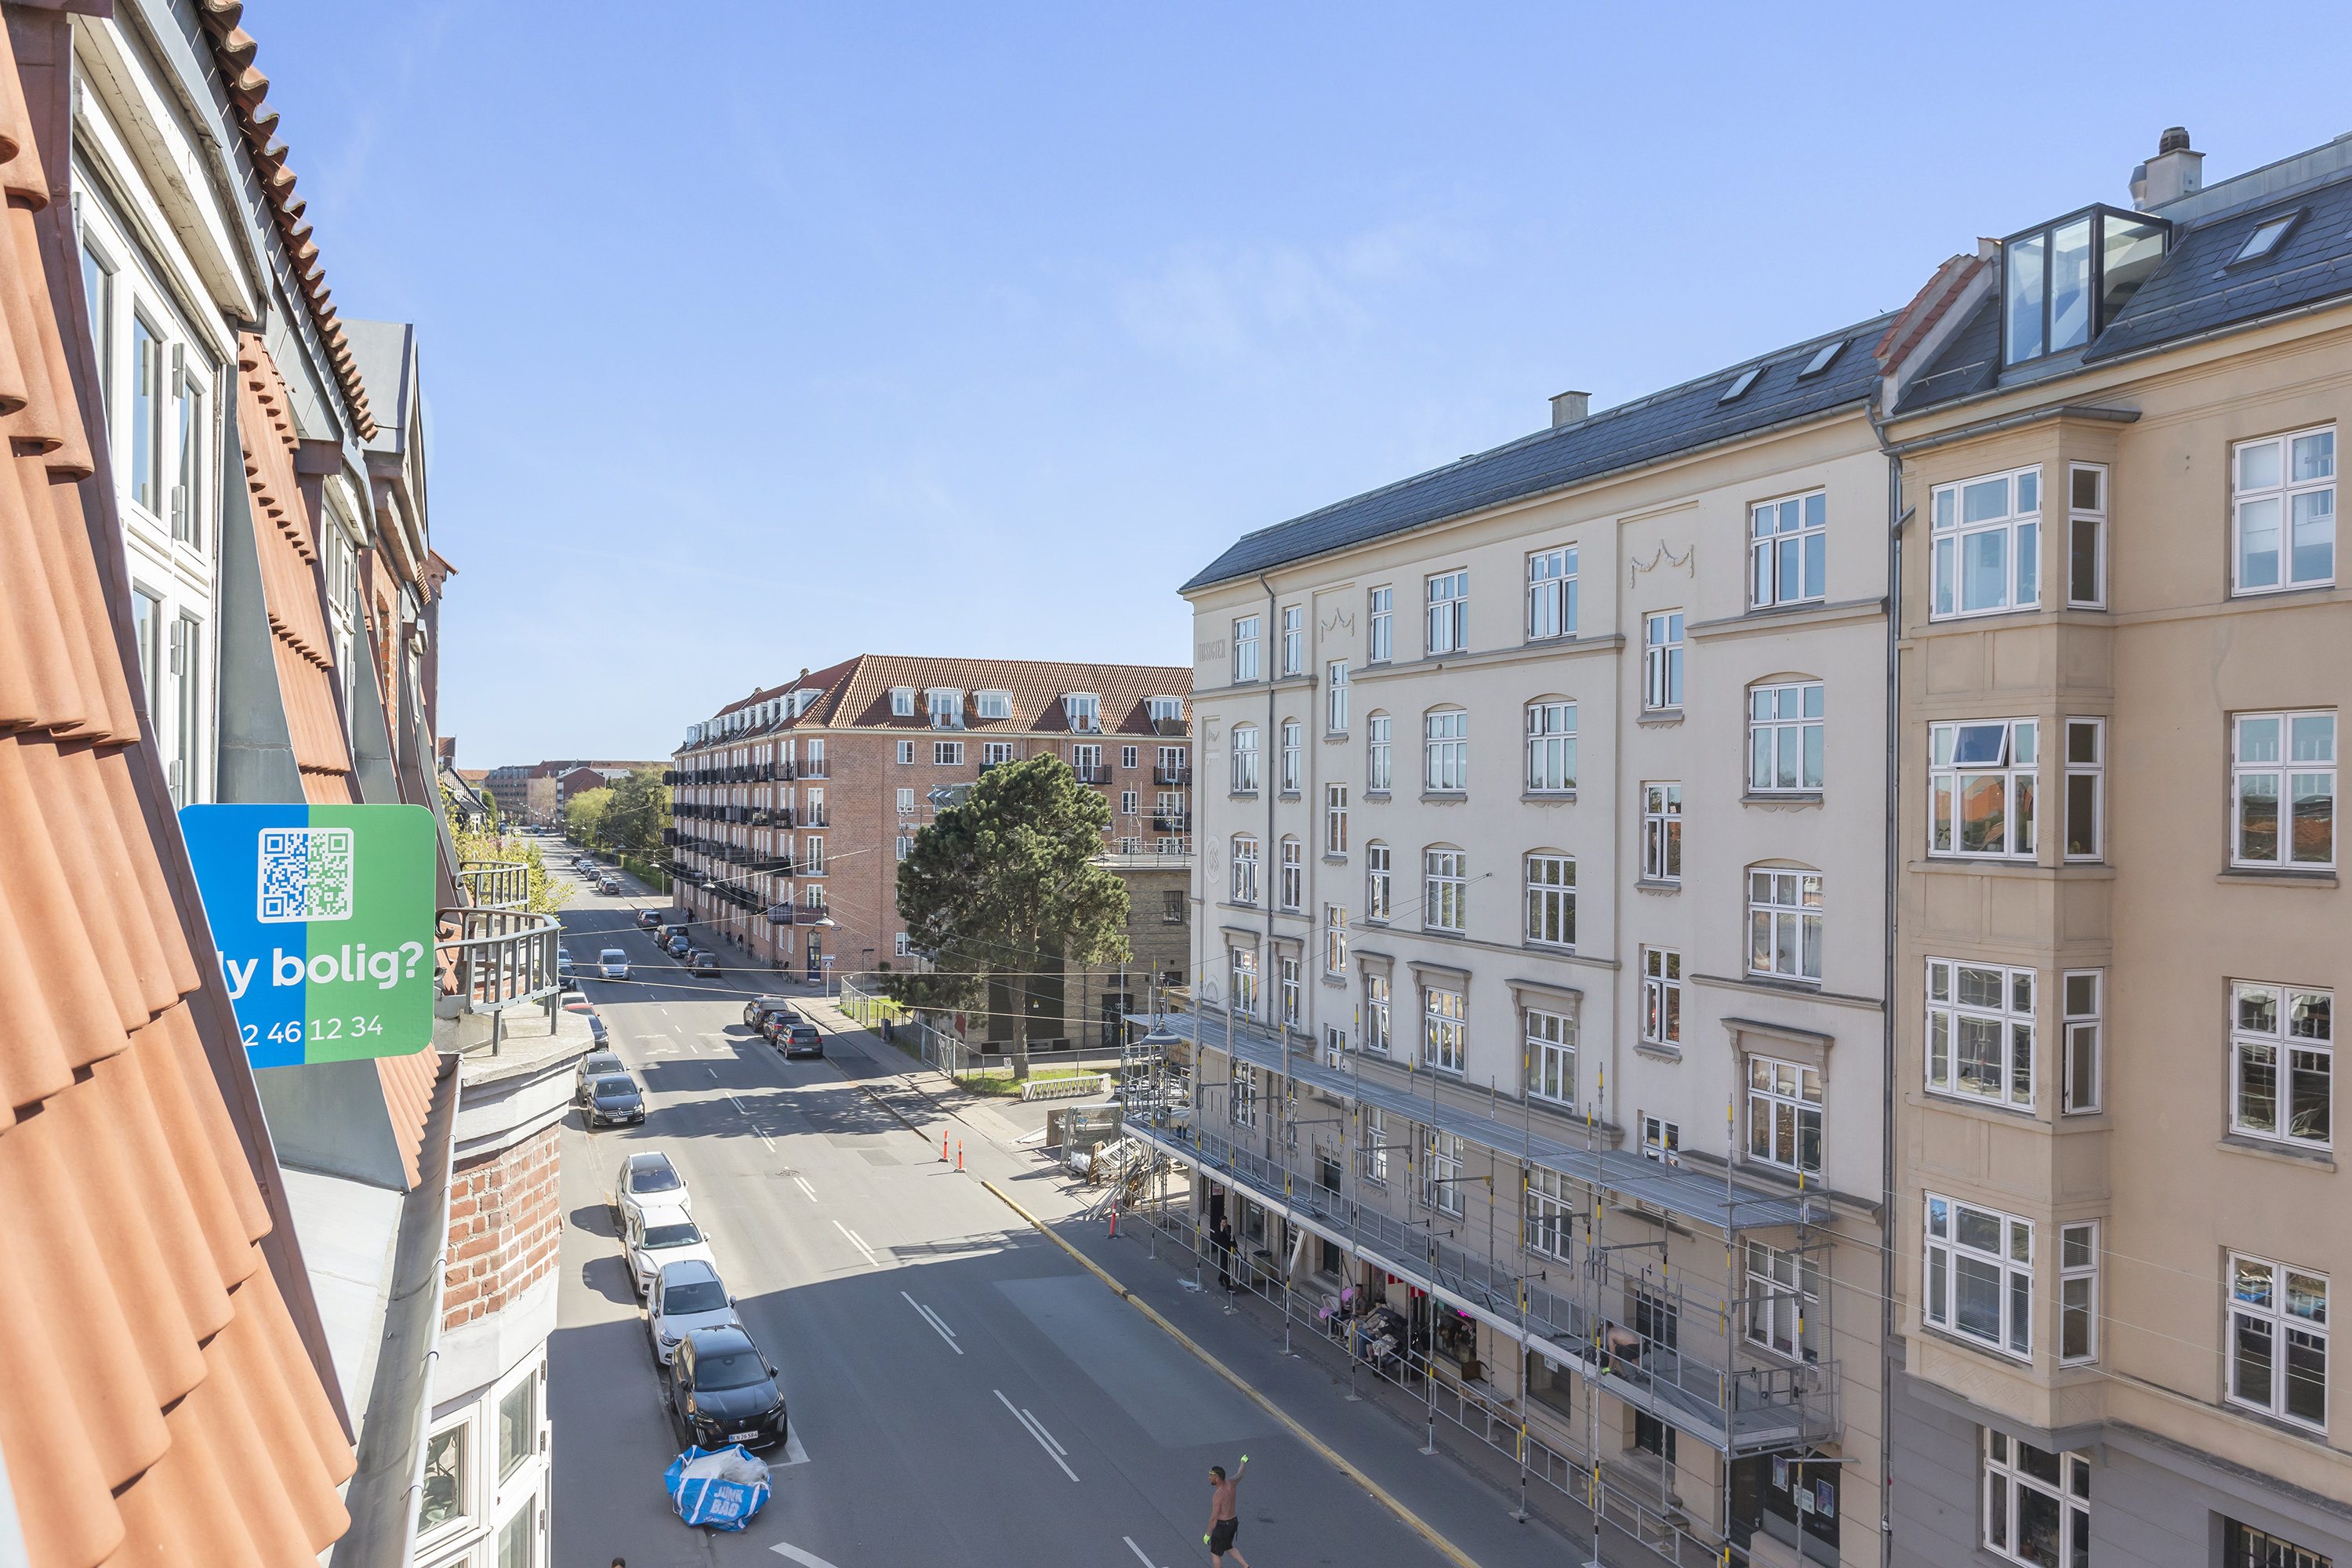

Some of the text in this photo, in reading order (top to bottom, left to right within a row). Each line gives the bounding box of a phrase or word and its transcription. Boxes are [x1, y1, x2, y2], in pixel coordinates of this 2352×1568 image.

[272, 941, 424, 989] bolig?
[242, 1015, 383, 1047] 2 46 12 34
[713, 1486, 744, 1503] JUNK
